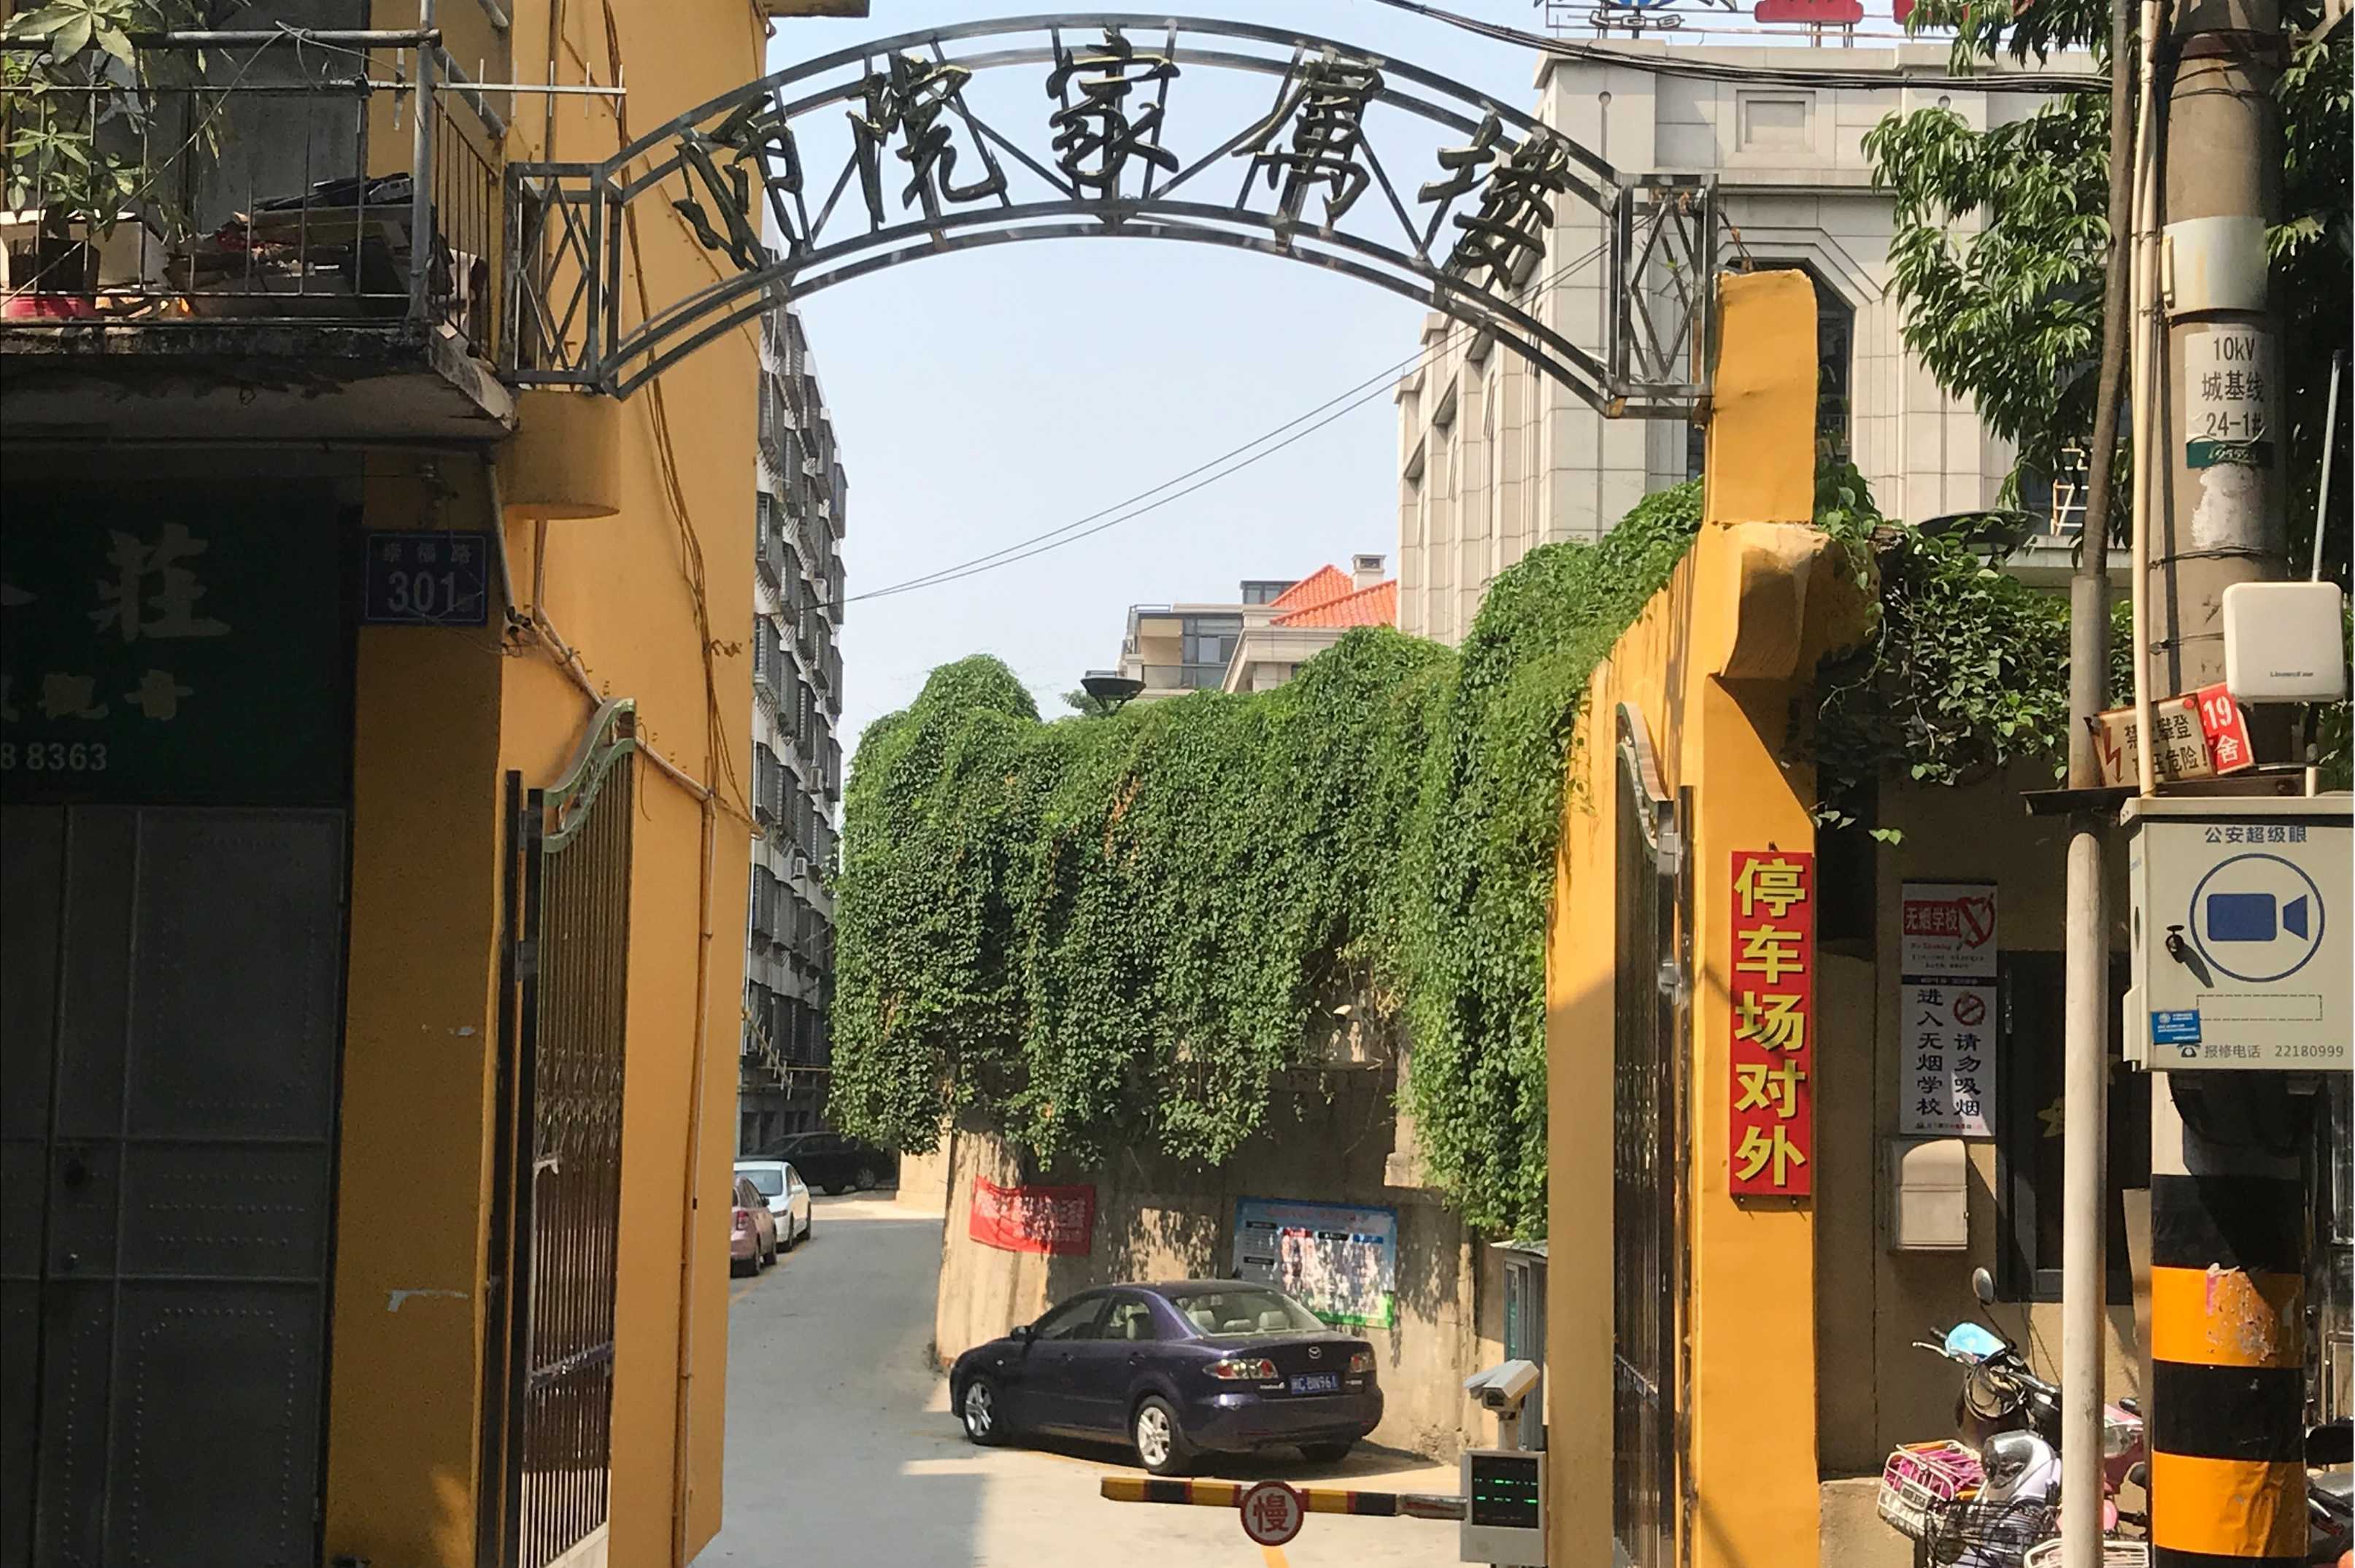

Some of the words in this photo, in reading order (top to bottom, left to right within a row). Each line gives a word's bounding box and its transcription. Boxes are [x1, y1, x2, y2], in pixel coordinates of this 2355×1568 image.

[2213, 336, 2255, 362] 10kV
[2201, 371, 2264, 403] 城基线
[387, 571, 455, 612] 301
[2203, 695, 2233, 730] 19
[2124, 714, 2192, 749] 禁攀登
[26, 743, 107, 771] 8363
[2132, 744, 2208, 776] 压危险!
[2214, 735, 2240, 764] 舍
[2205, 826, 2307, 844] 公安超级眼
[1905, 907, 1959, 931] 无烟学校
[1735, 857, 1805, 1188] 停车场对外
[1916, 988, 1943, 1116] 进入无烟学校
[2204, 1045, 2261, 1059] 报修电话
[2275, 1045, 2344, 1058] 22180999
[1954, 1032, 1981, 1117] 请勿吸烟
[1252, 1493, 1290, 1533] 慢
